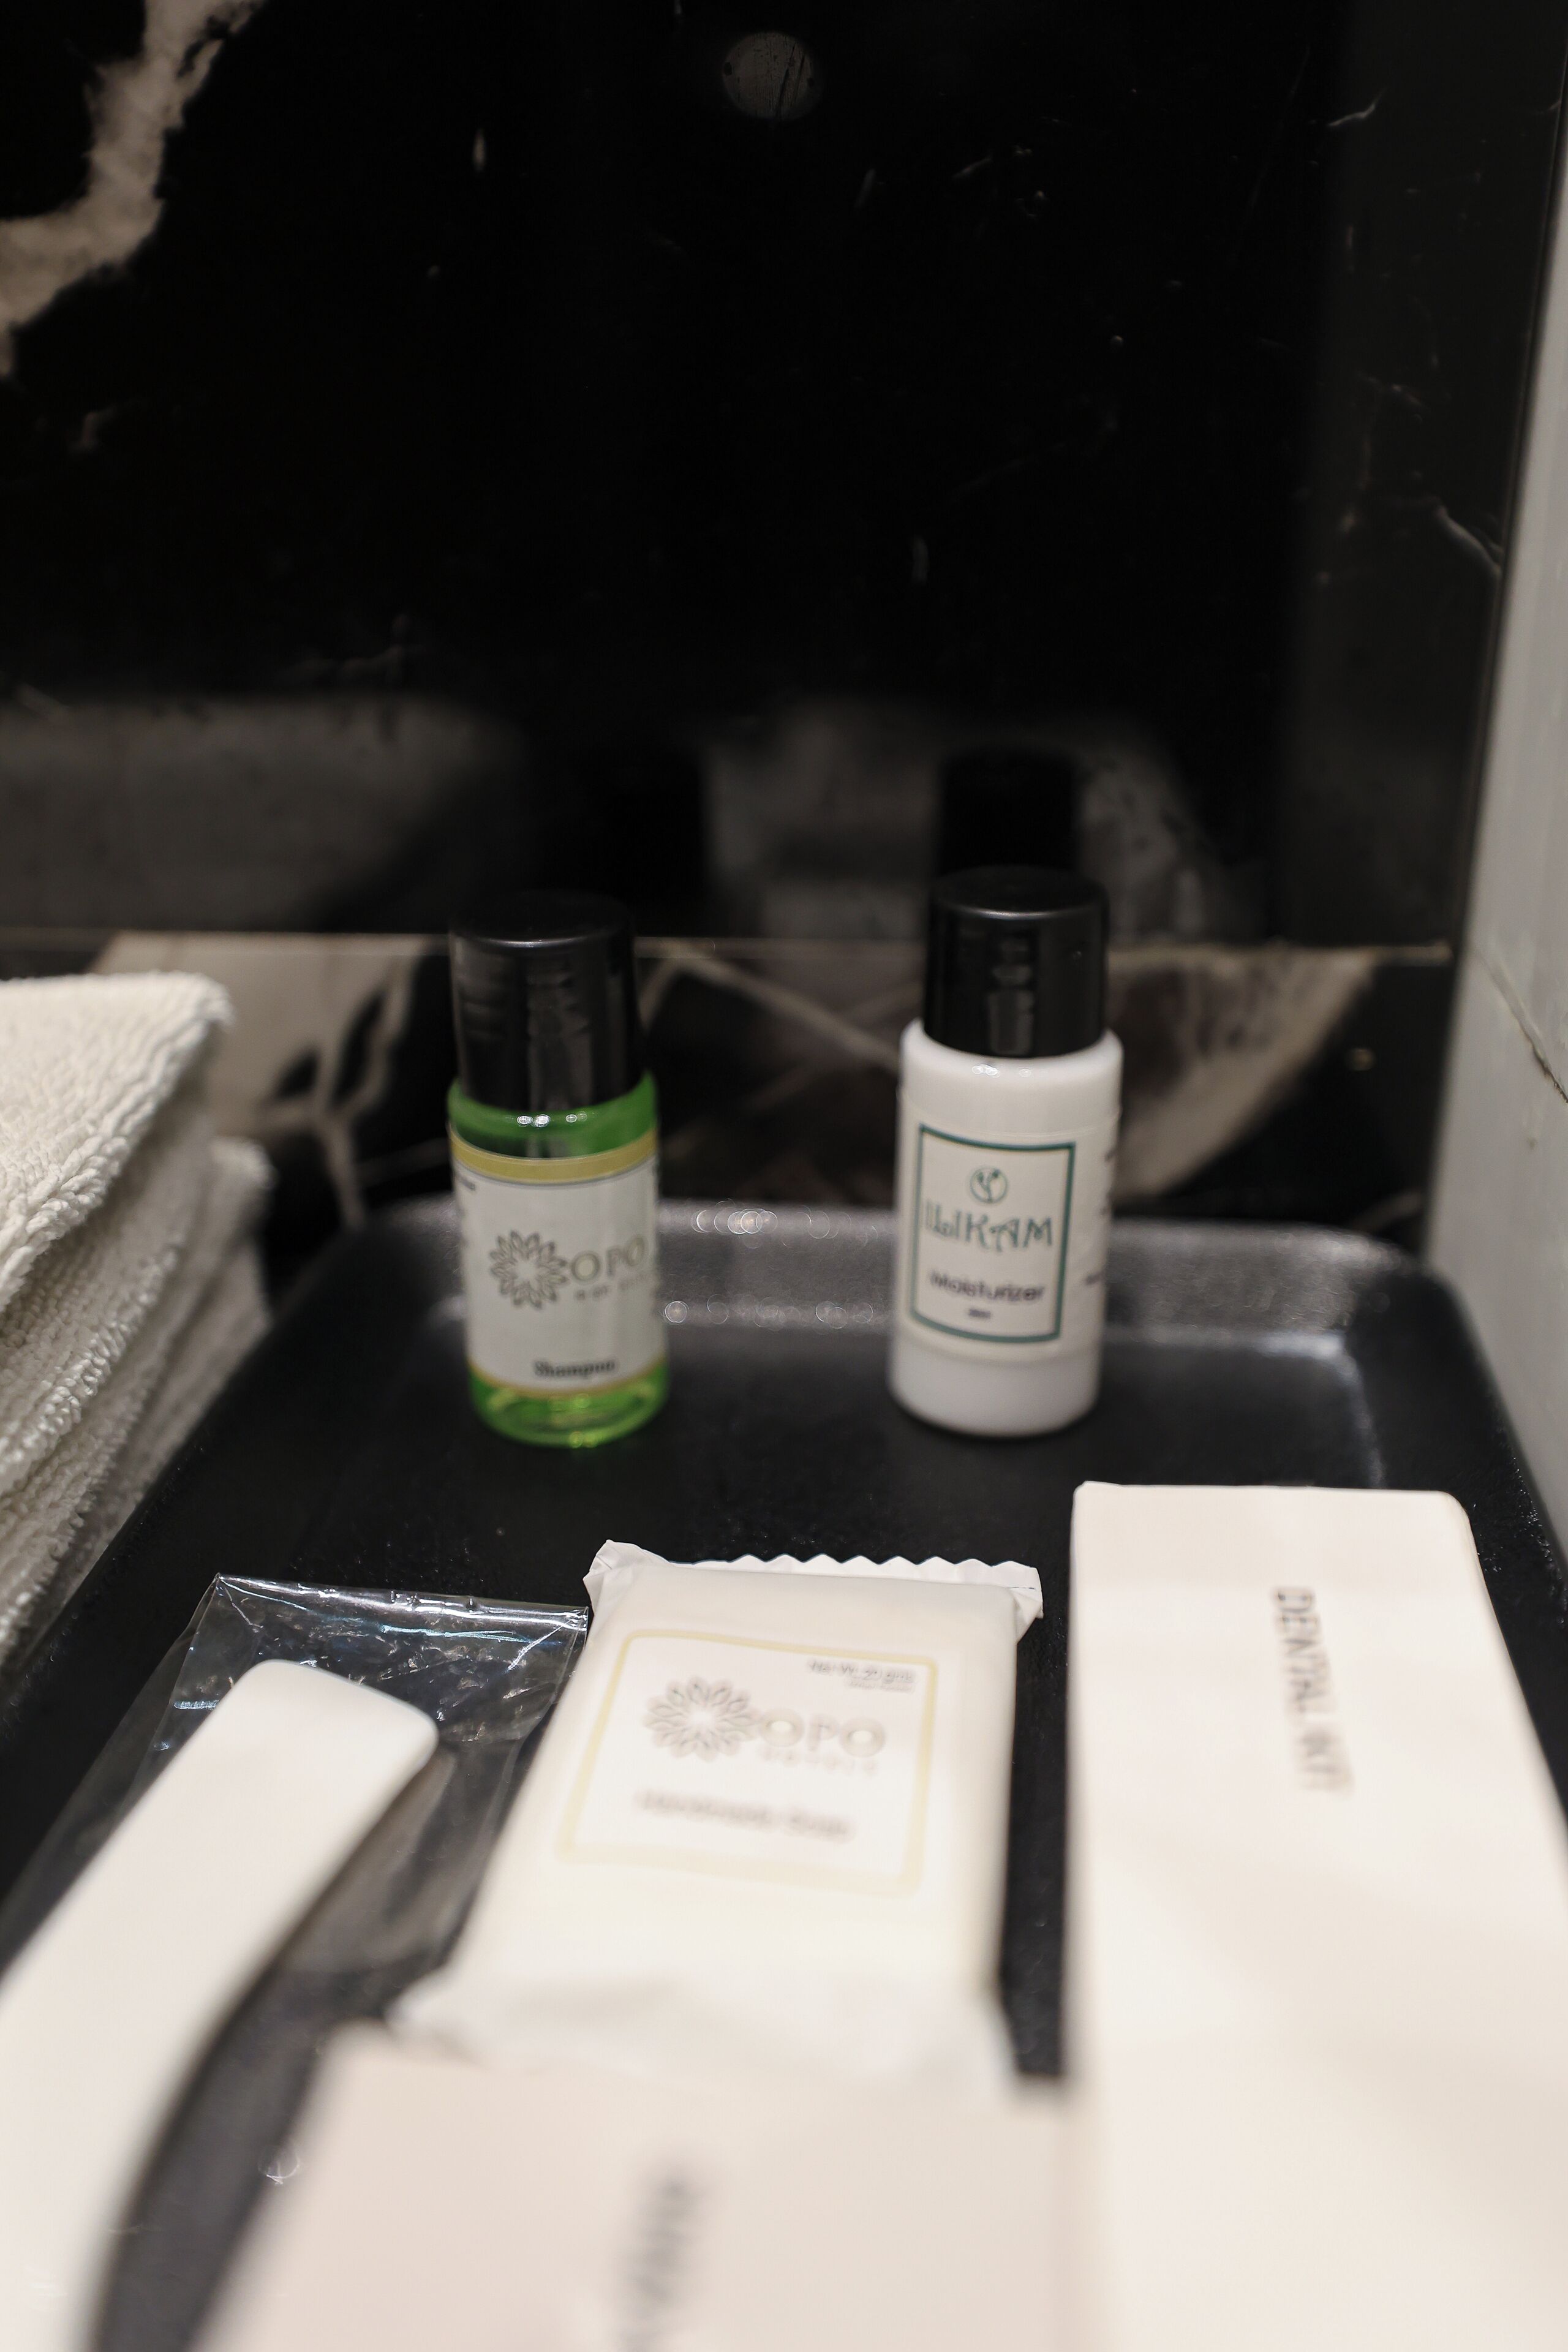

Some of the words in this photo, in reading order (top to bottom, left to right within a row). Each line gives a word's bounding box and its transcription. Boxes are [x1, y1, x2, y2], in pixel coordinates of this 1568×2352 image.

[570, 1234, 646, 1281] OPO
[930, 1270, 1044, 1302] Moisturizer
[533, 1359, 616, 1379] Shampoo
[759, 1707, 886, 1757] OPO
